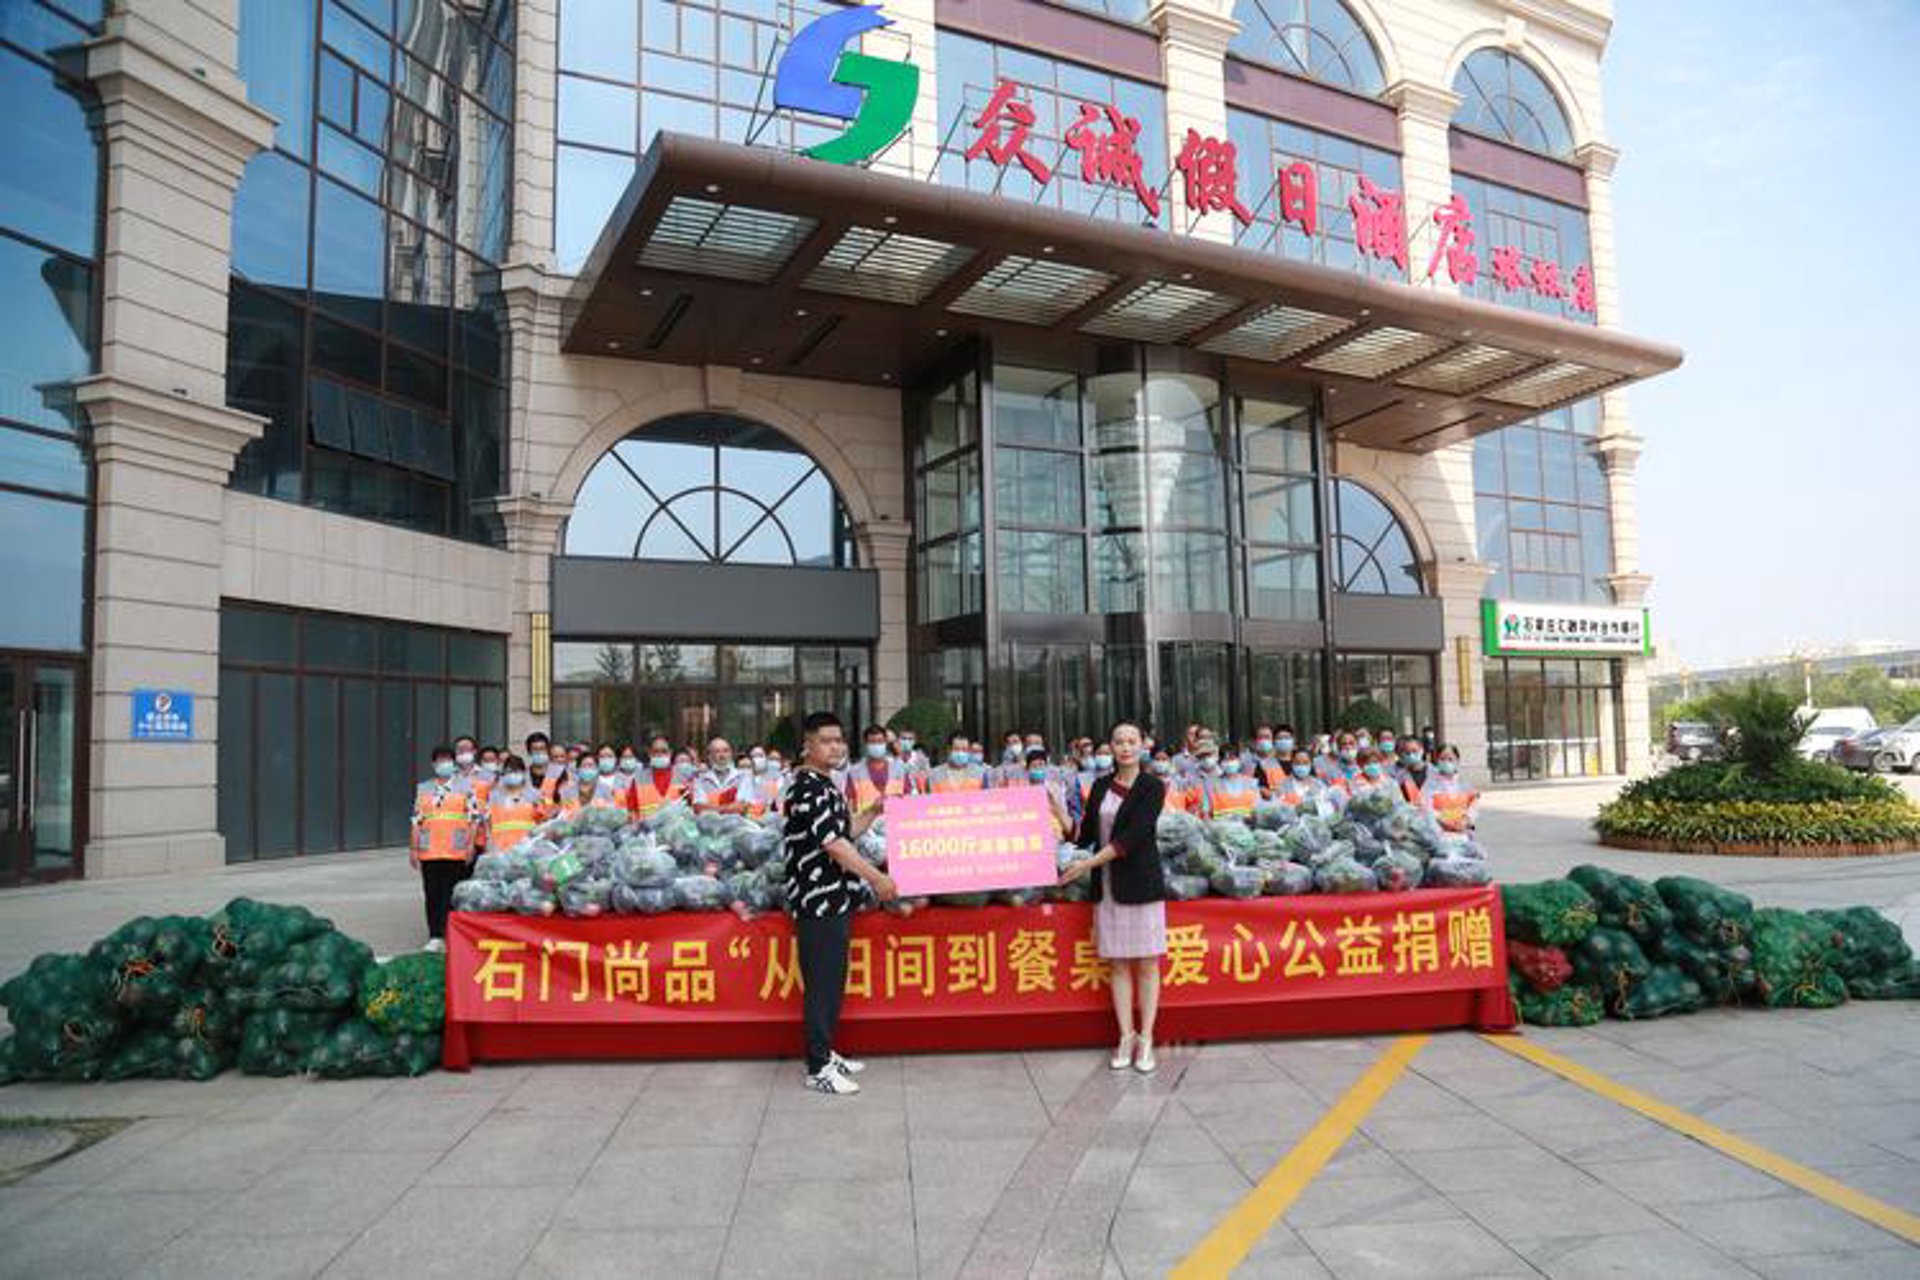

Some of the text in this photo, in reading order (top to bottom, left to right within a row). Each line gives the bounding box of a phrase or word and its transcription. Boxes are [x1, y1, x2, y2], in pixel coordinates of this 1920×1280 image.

[965, 79, 1477, 285] 众诚假日酒店
